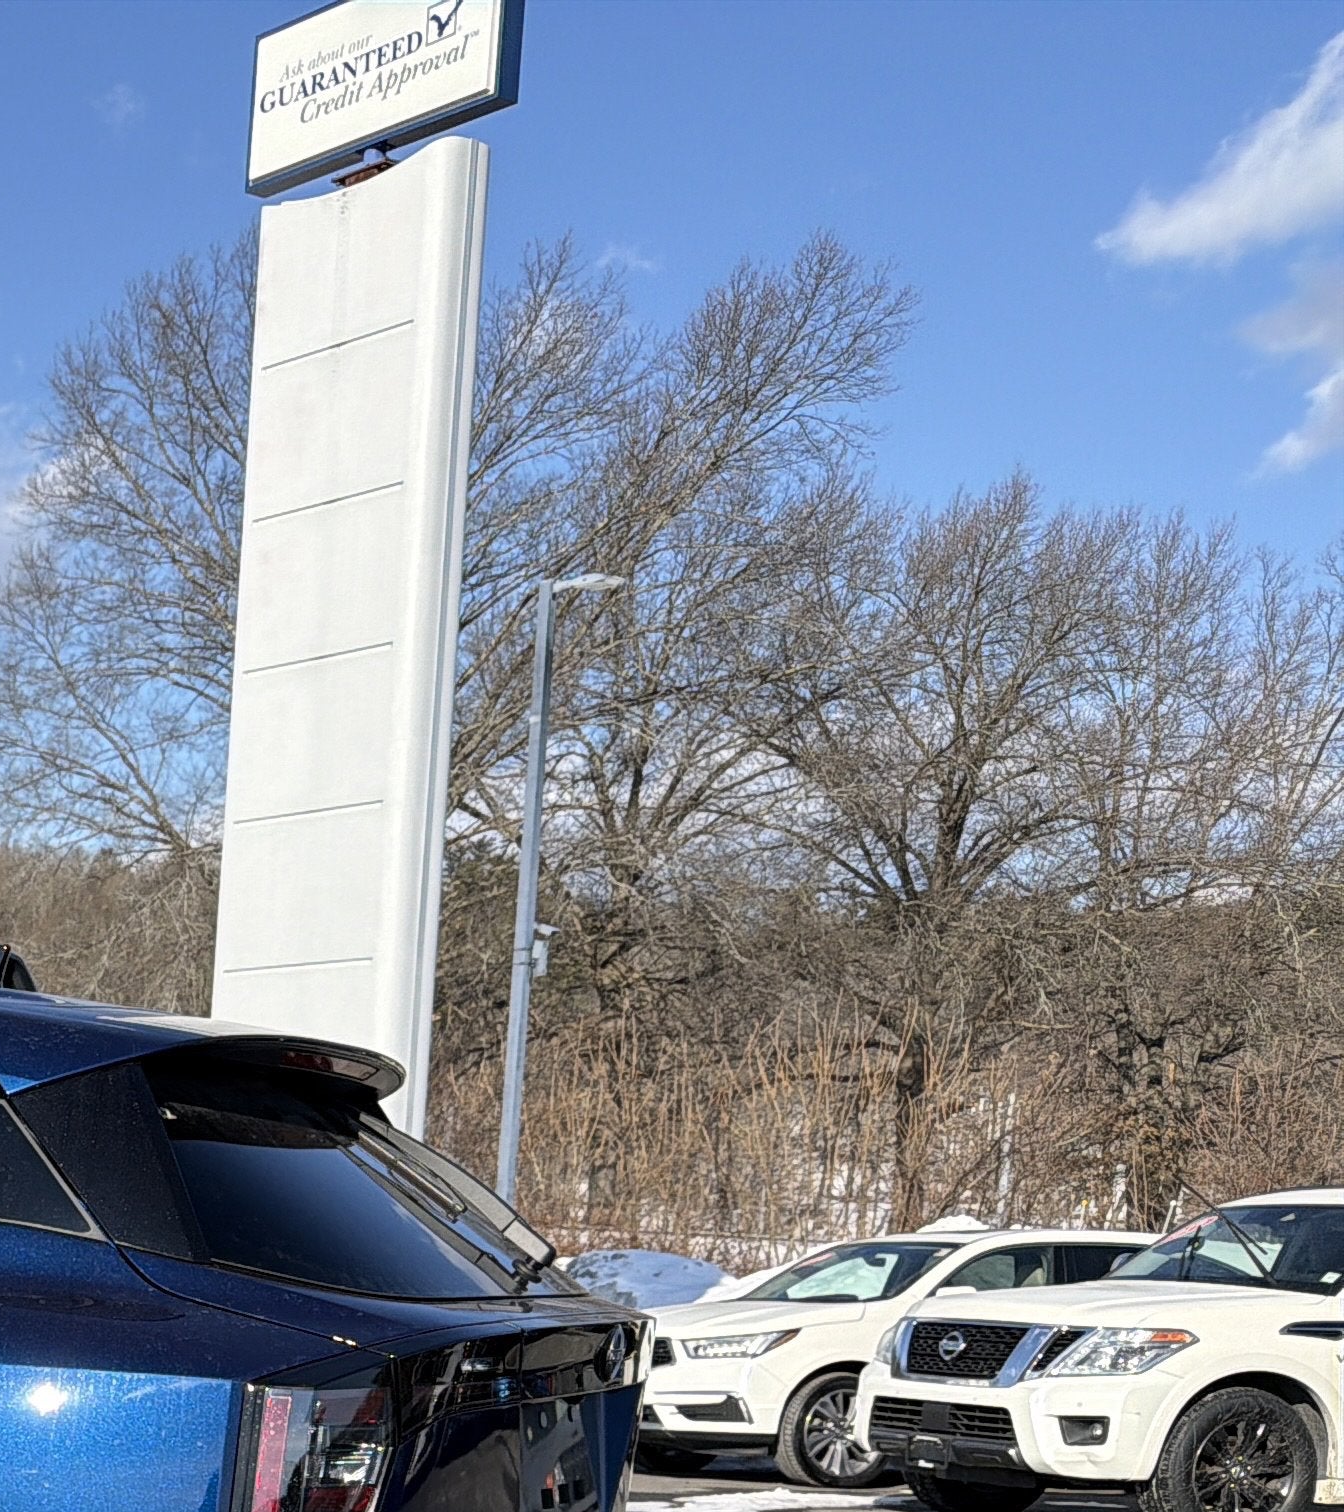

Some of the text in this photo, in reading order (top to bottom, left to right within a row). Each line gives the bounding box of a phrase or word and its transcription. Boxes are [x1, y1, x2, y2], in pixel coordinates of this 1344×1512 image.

[259, 30, 424, 114] GUARANTEED
[278, 34, 373, 82] Ask about our
[300, 33, 470, 124] Credit Approval
